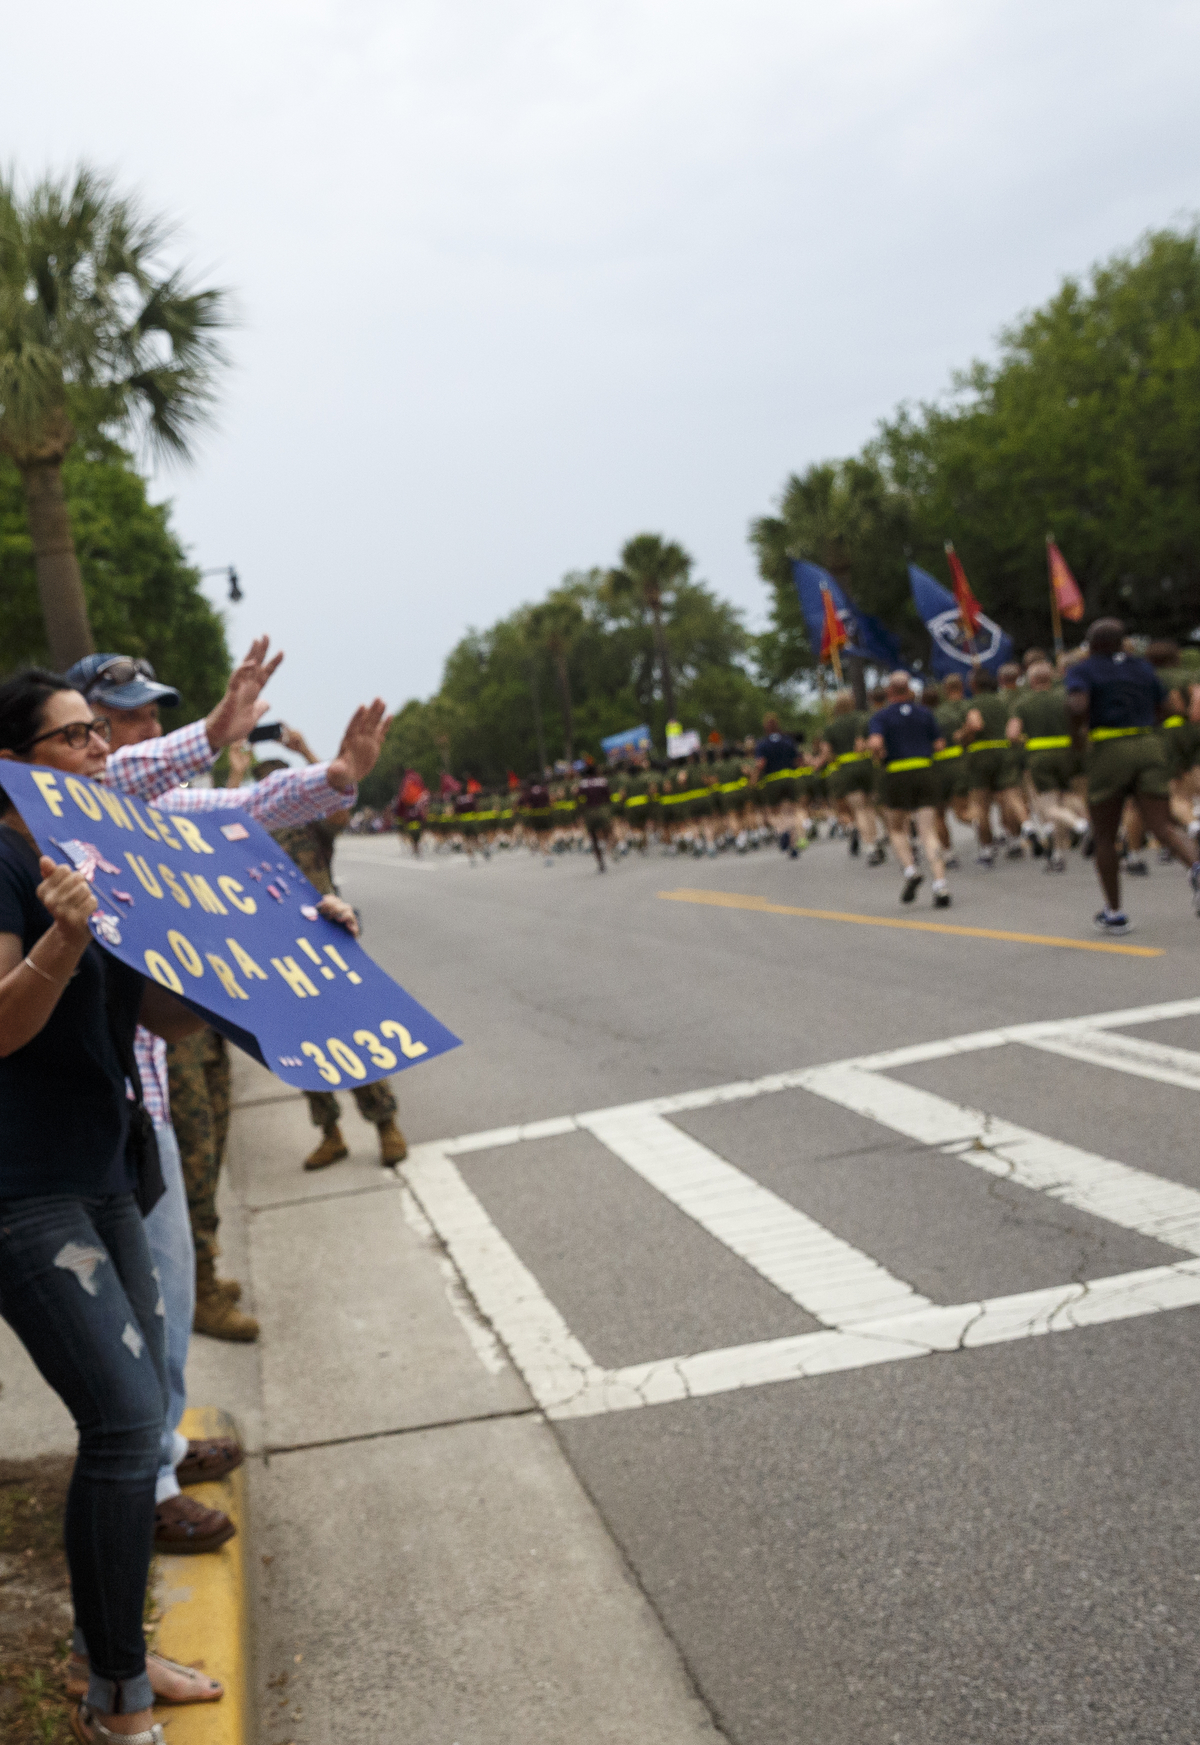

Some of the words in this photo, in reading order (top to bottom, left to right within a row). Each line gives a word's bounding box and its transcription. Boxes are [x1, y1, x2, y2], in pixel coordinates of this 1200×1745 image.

[30, 770, 215, 854] FOWLER
[123, 851, 258, 916] USMC
[300, 1019, 429, 1086] 3032
